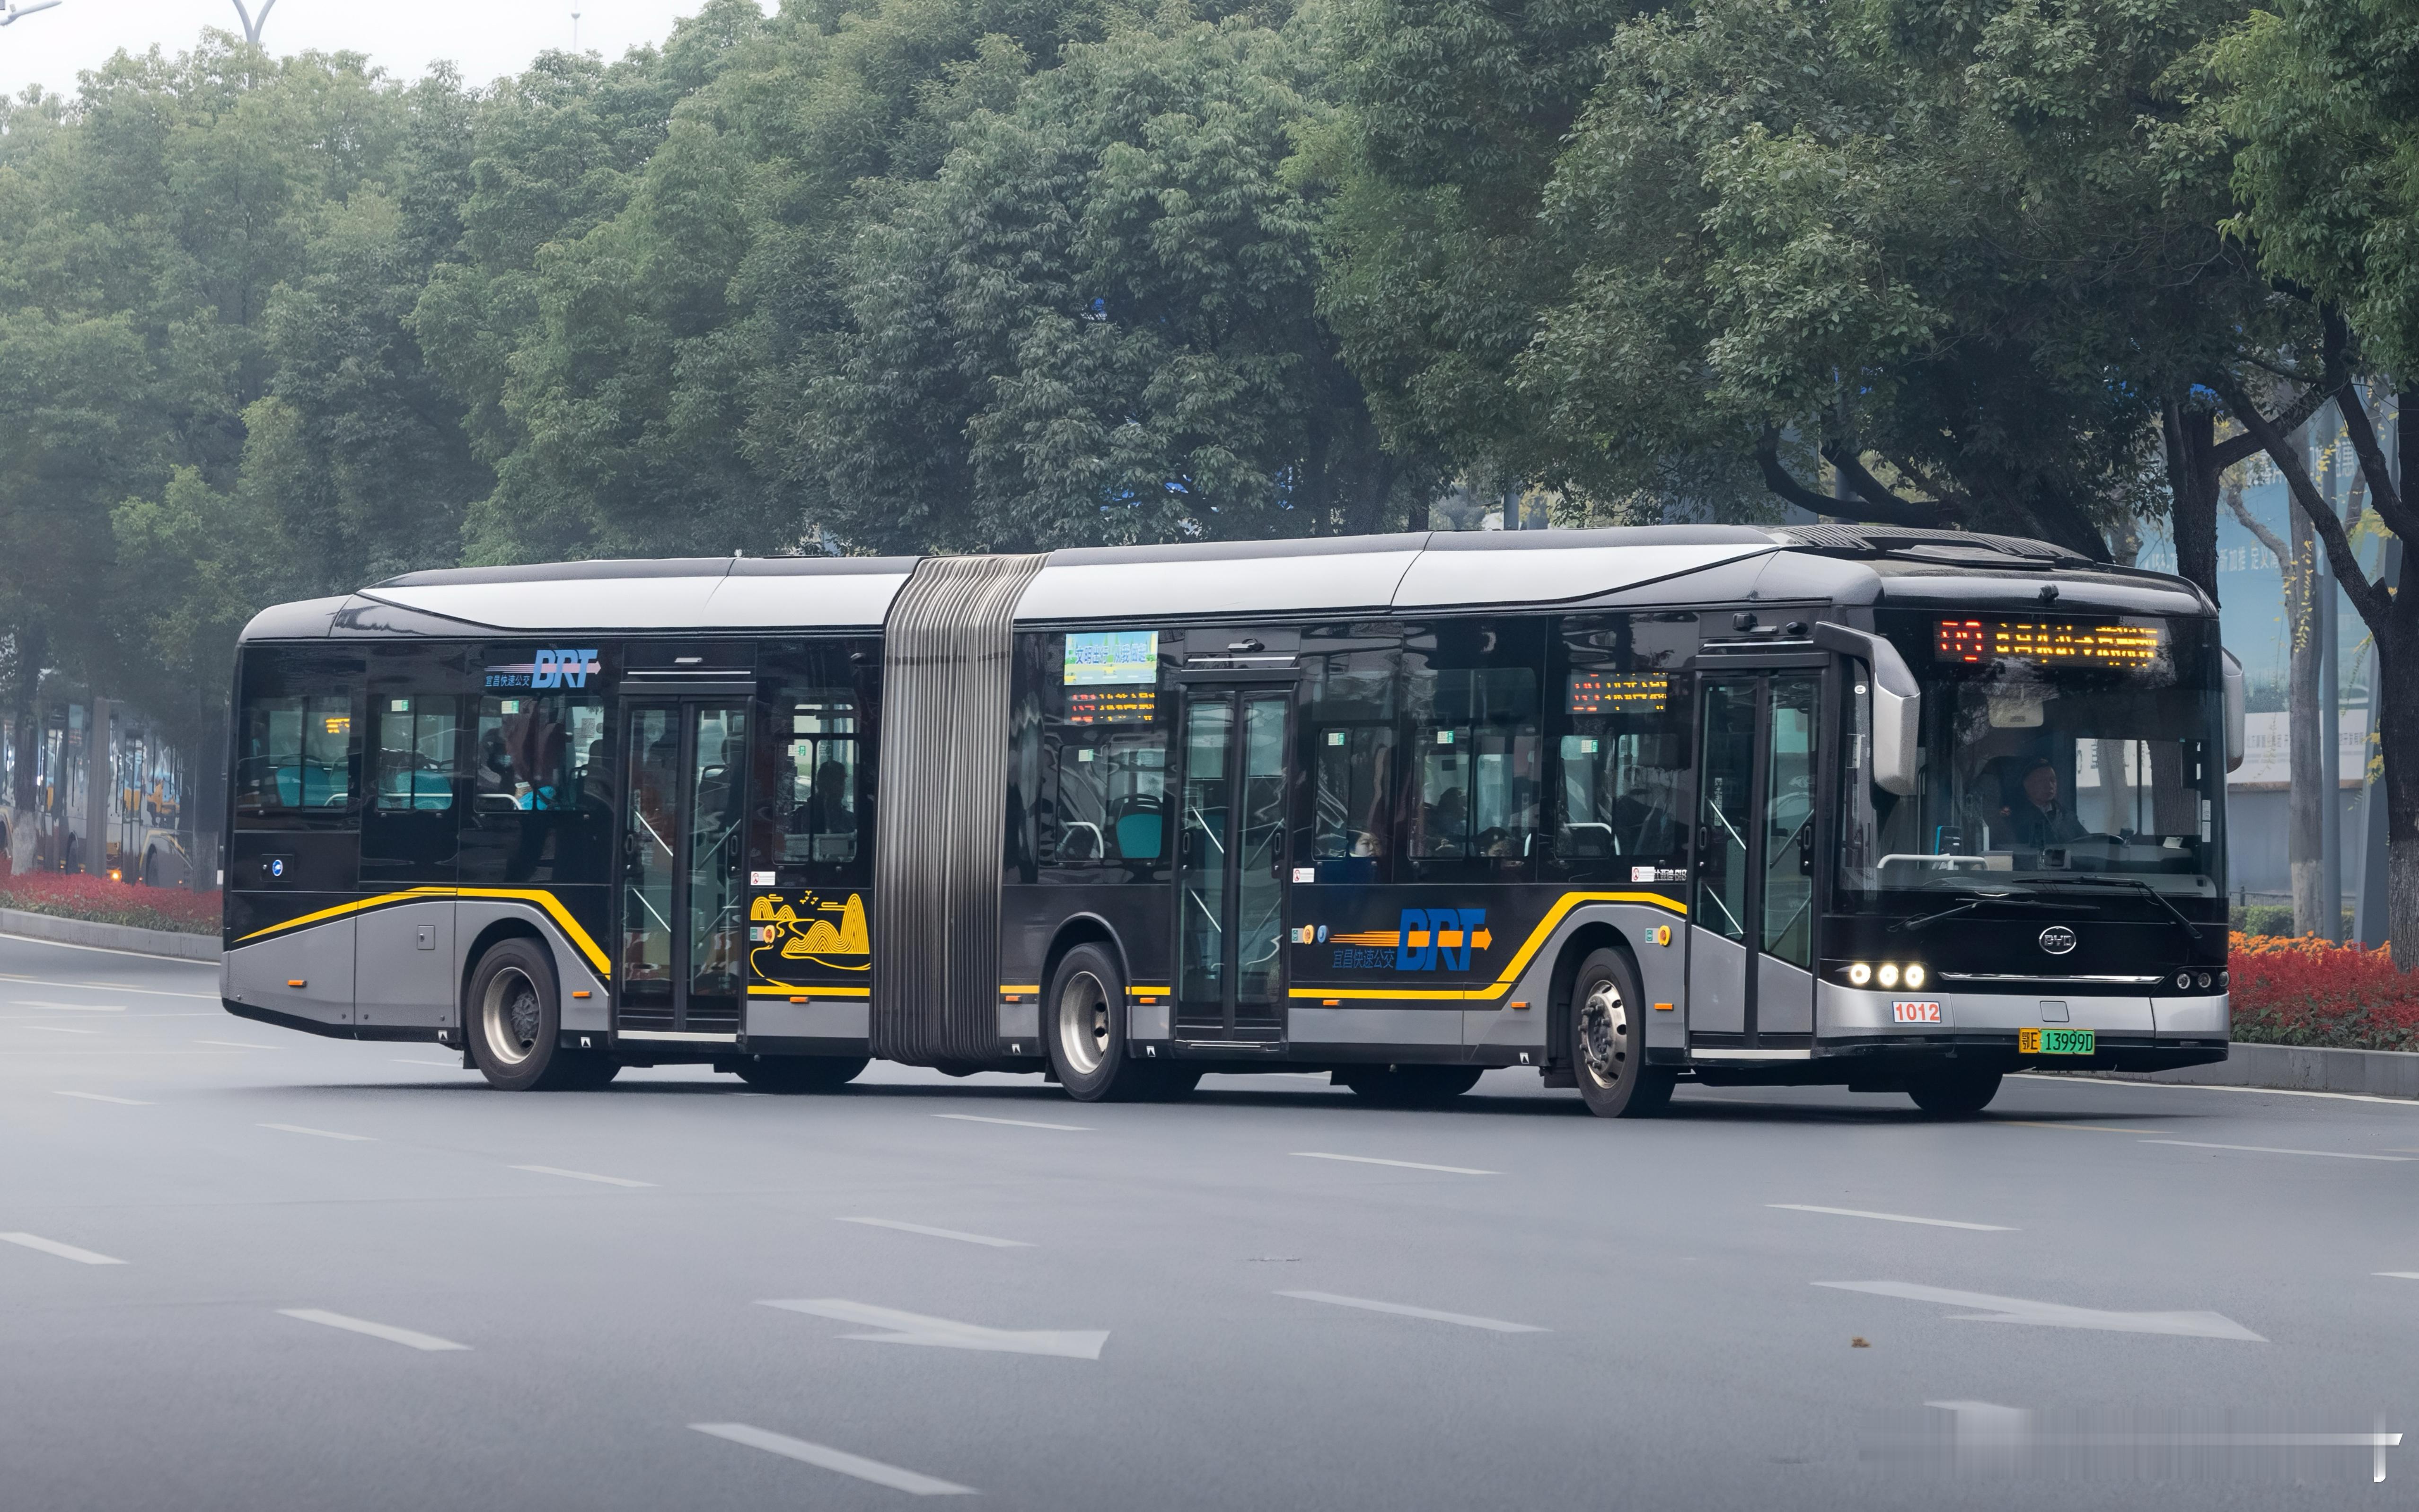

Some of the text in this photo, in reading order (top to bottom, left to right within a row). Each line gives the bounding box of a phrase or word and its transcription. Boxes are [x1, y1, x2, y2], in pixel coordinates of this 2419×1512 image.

[531, 650, 598, 688] BRT
[484, 675, 530, 687] 宜昌快速公交
[1396, 908, 1487, 971] BRT
[2044, 935, 2072, 946] BYD
[1332, 949, 1395, 969] 宜昌快速公交
[1896, 1003, 1940, 1020] 1012
